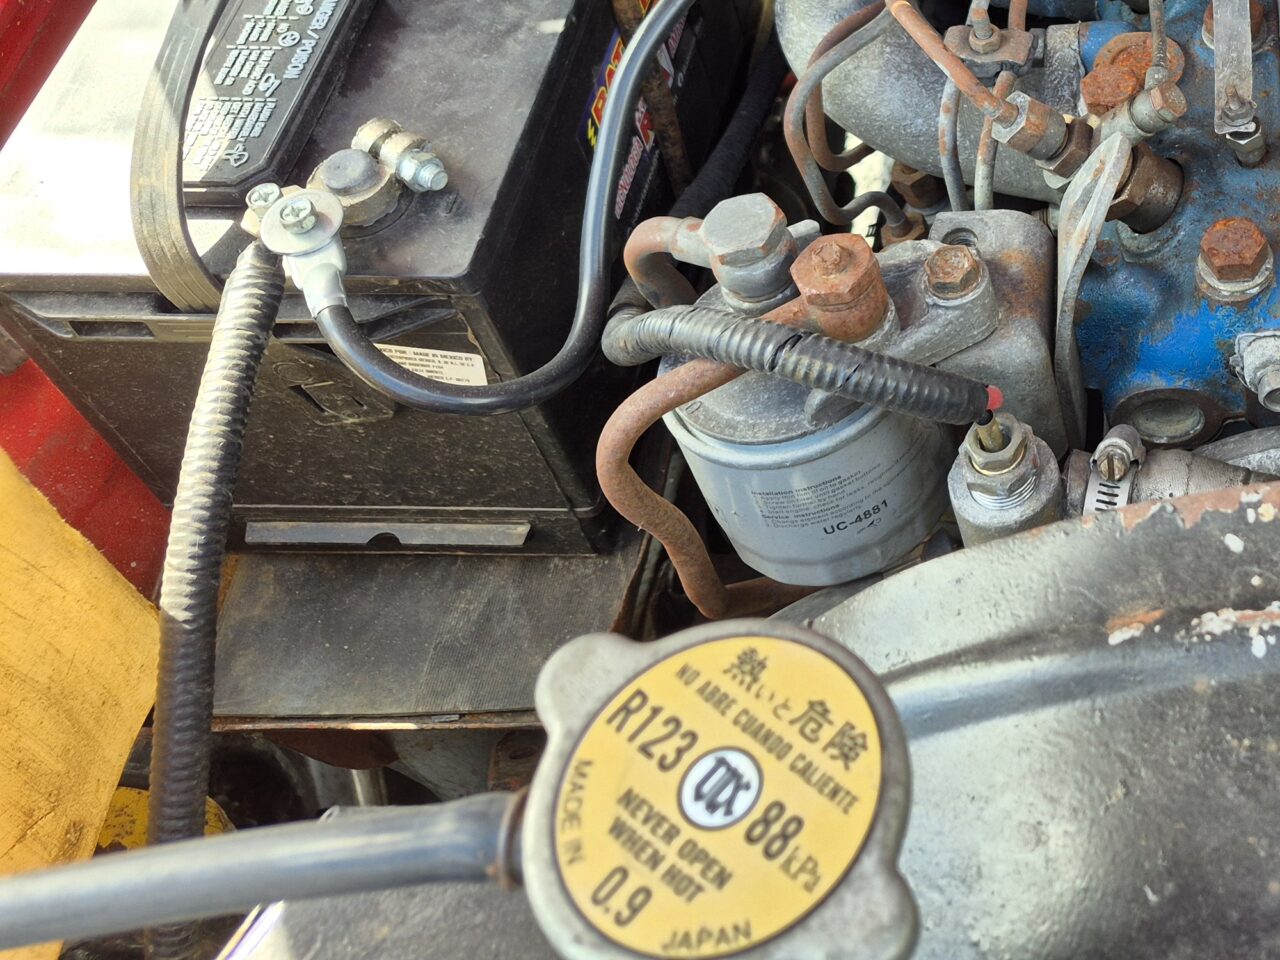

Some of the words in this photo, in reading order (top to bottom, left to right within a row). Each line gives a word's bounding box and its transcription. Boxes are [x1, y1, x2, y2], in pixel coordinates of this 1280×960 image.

[283, 40, 317, 79] POISON
[823, 499, 888, 535] UC-4881
[605, 688, 700, 773] R123
[674, 663, 695, 687] NO
[695, 679, 737, 718] ABRE
[731, 707, 794, 763] CUANDO
[788, 753, 861, 816] CALIENTE
[722, 646, 869, 771] 熱いと危険
[560, 759, 594, 832] MADE
[563, 839, 585, 868] IN
[607, 815, 664, 872] WHEN
[661, 866, 707, 906] HOT
[617, 787, 681, 845] NEVER
[677, 839, 734, 892] OPEN
[590, 864, 653, 928] 0.9
[660, 919, 753, 953] JAPAN
